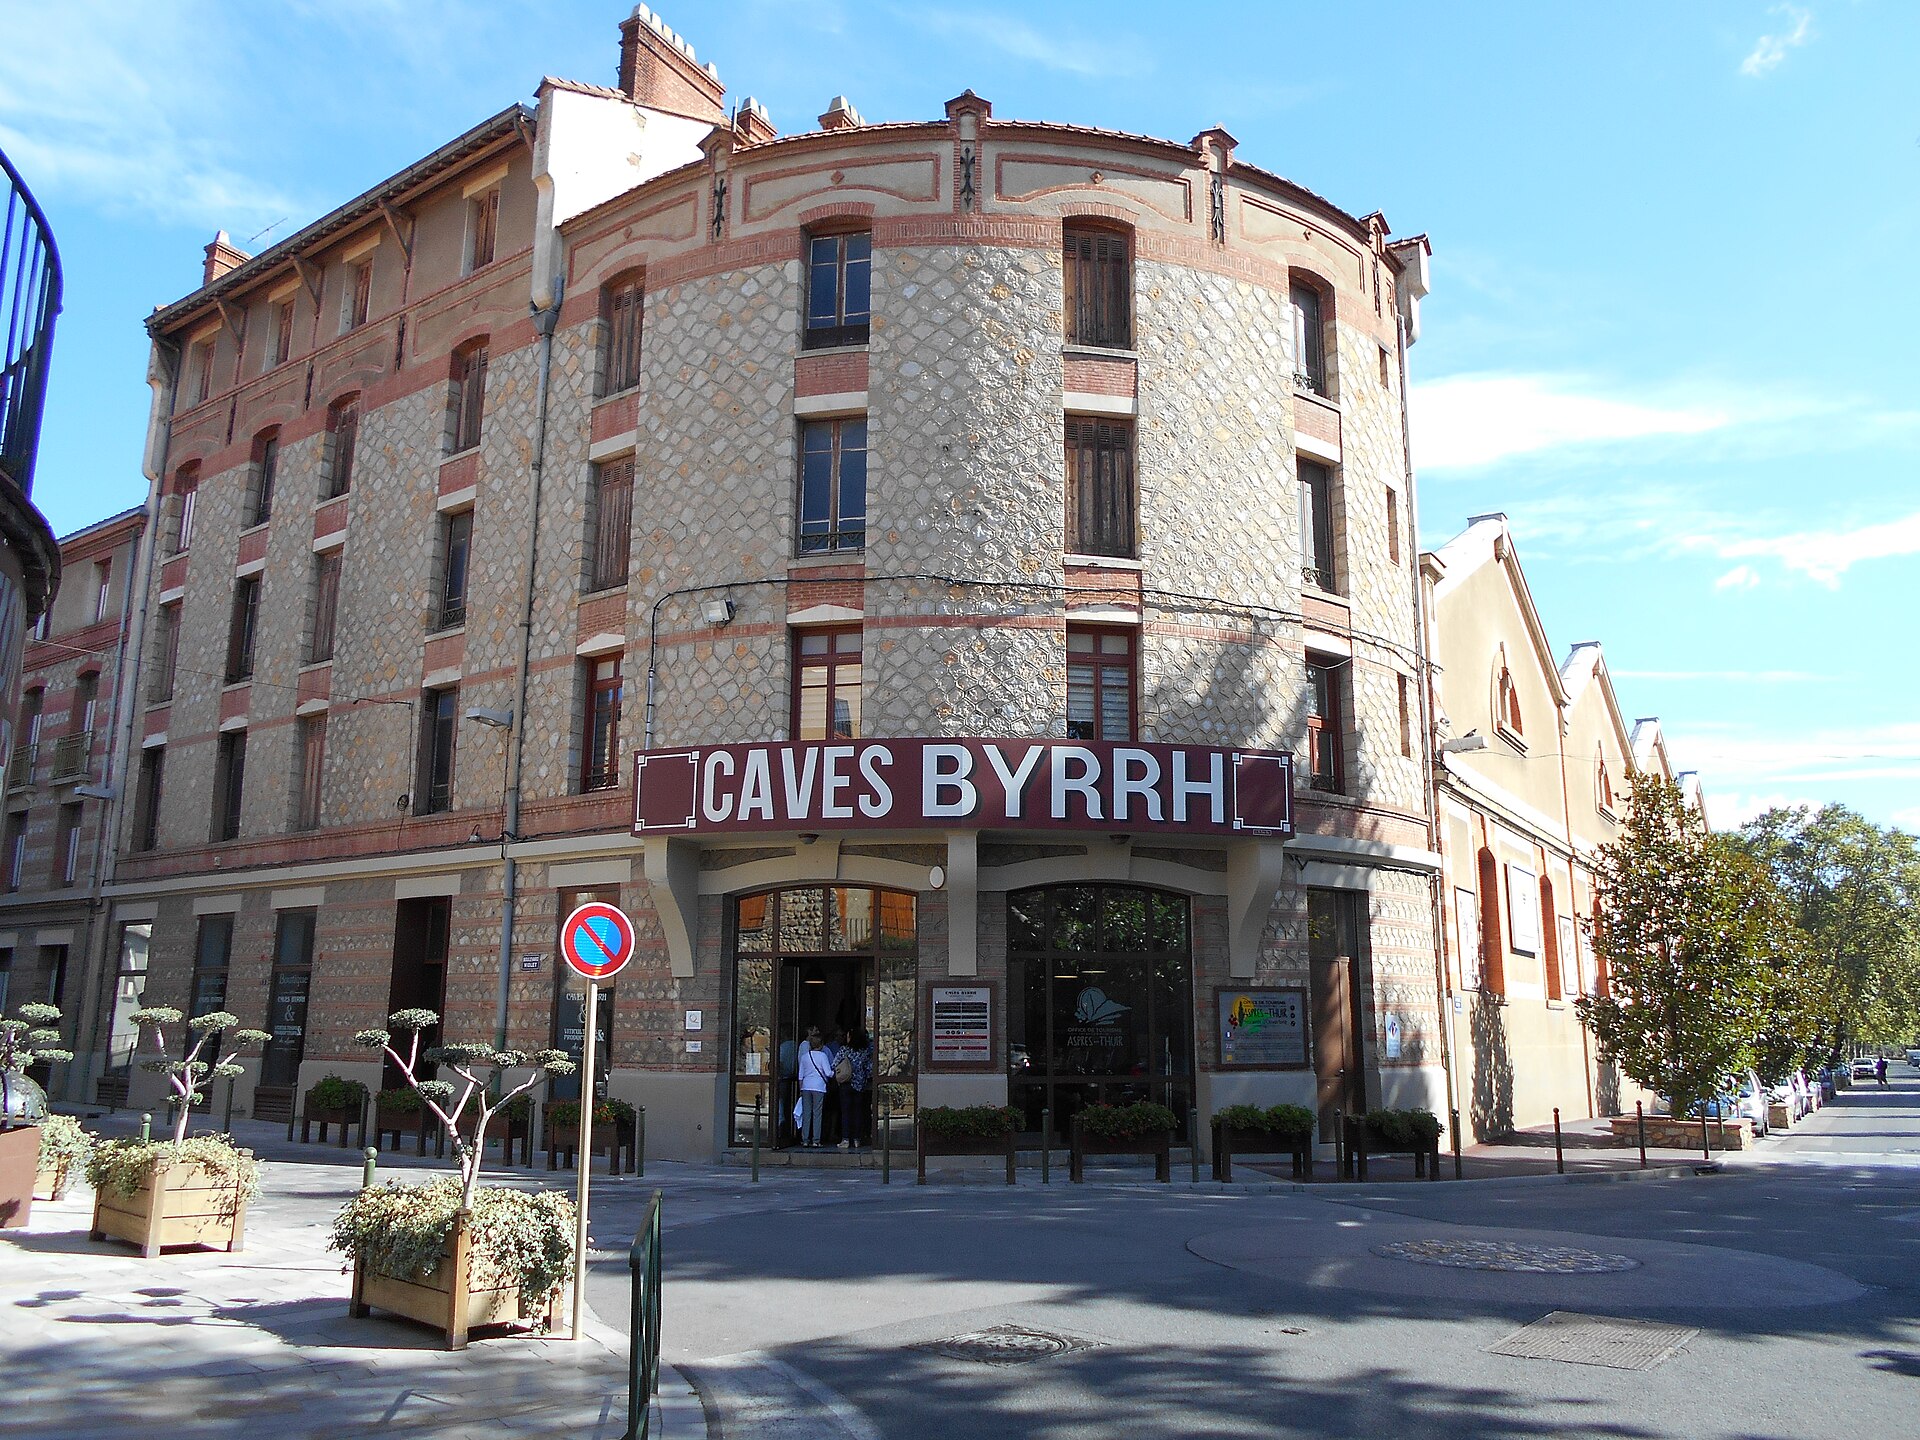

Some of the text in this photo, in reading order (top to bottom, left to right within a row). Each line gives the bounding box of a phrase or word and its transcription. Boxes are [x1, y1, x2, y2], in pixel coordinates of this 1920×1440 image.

[702, 743, 1224, 823] CAVES BYRRH
[566, 993, 585, 1001] CAVES
